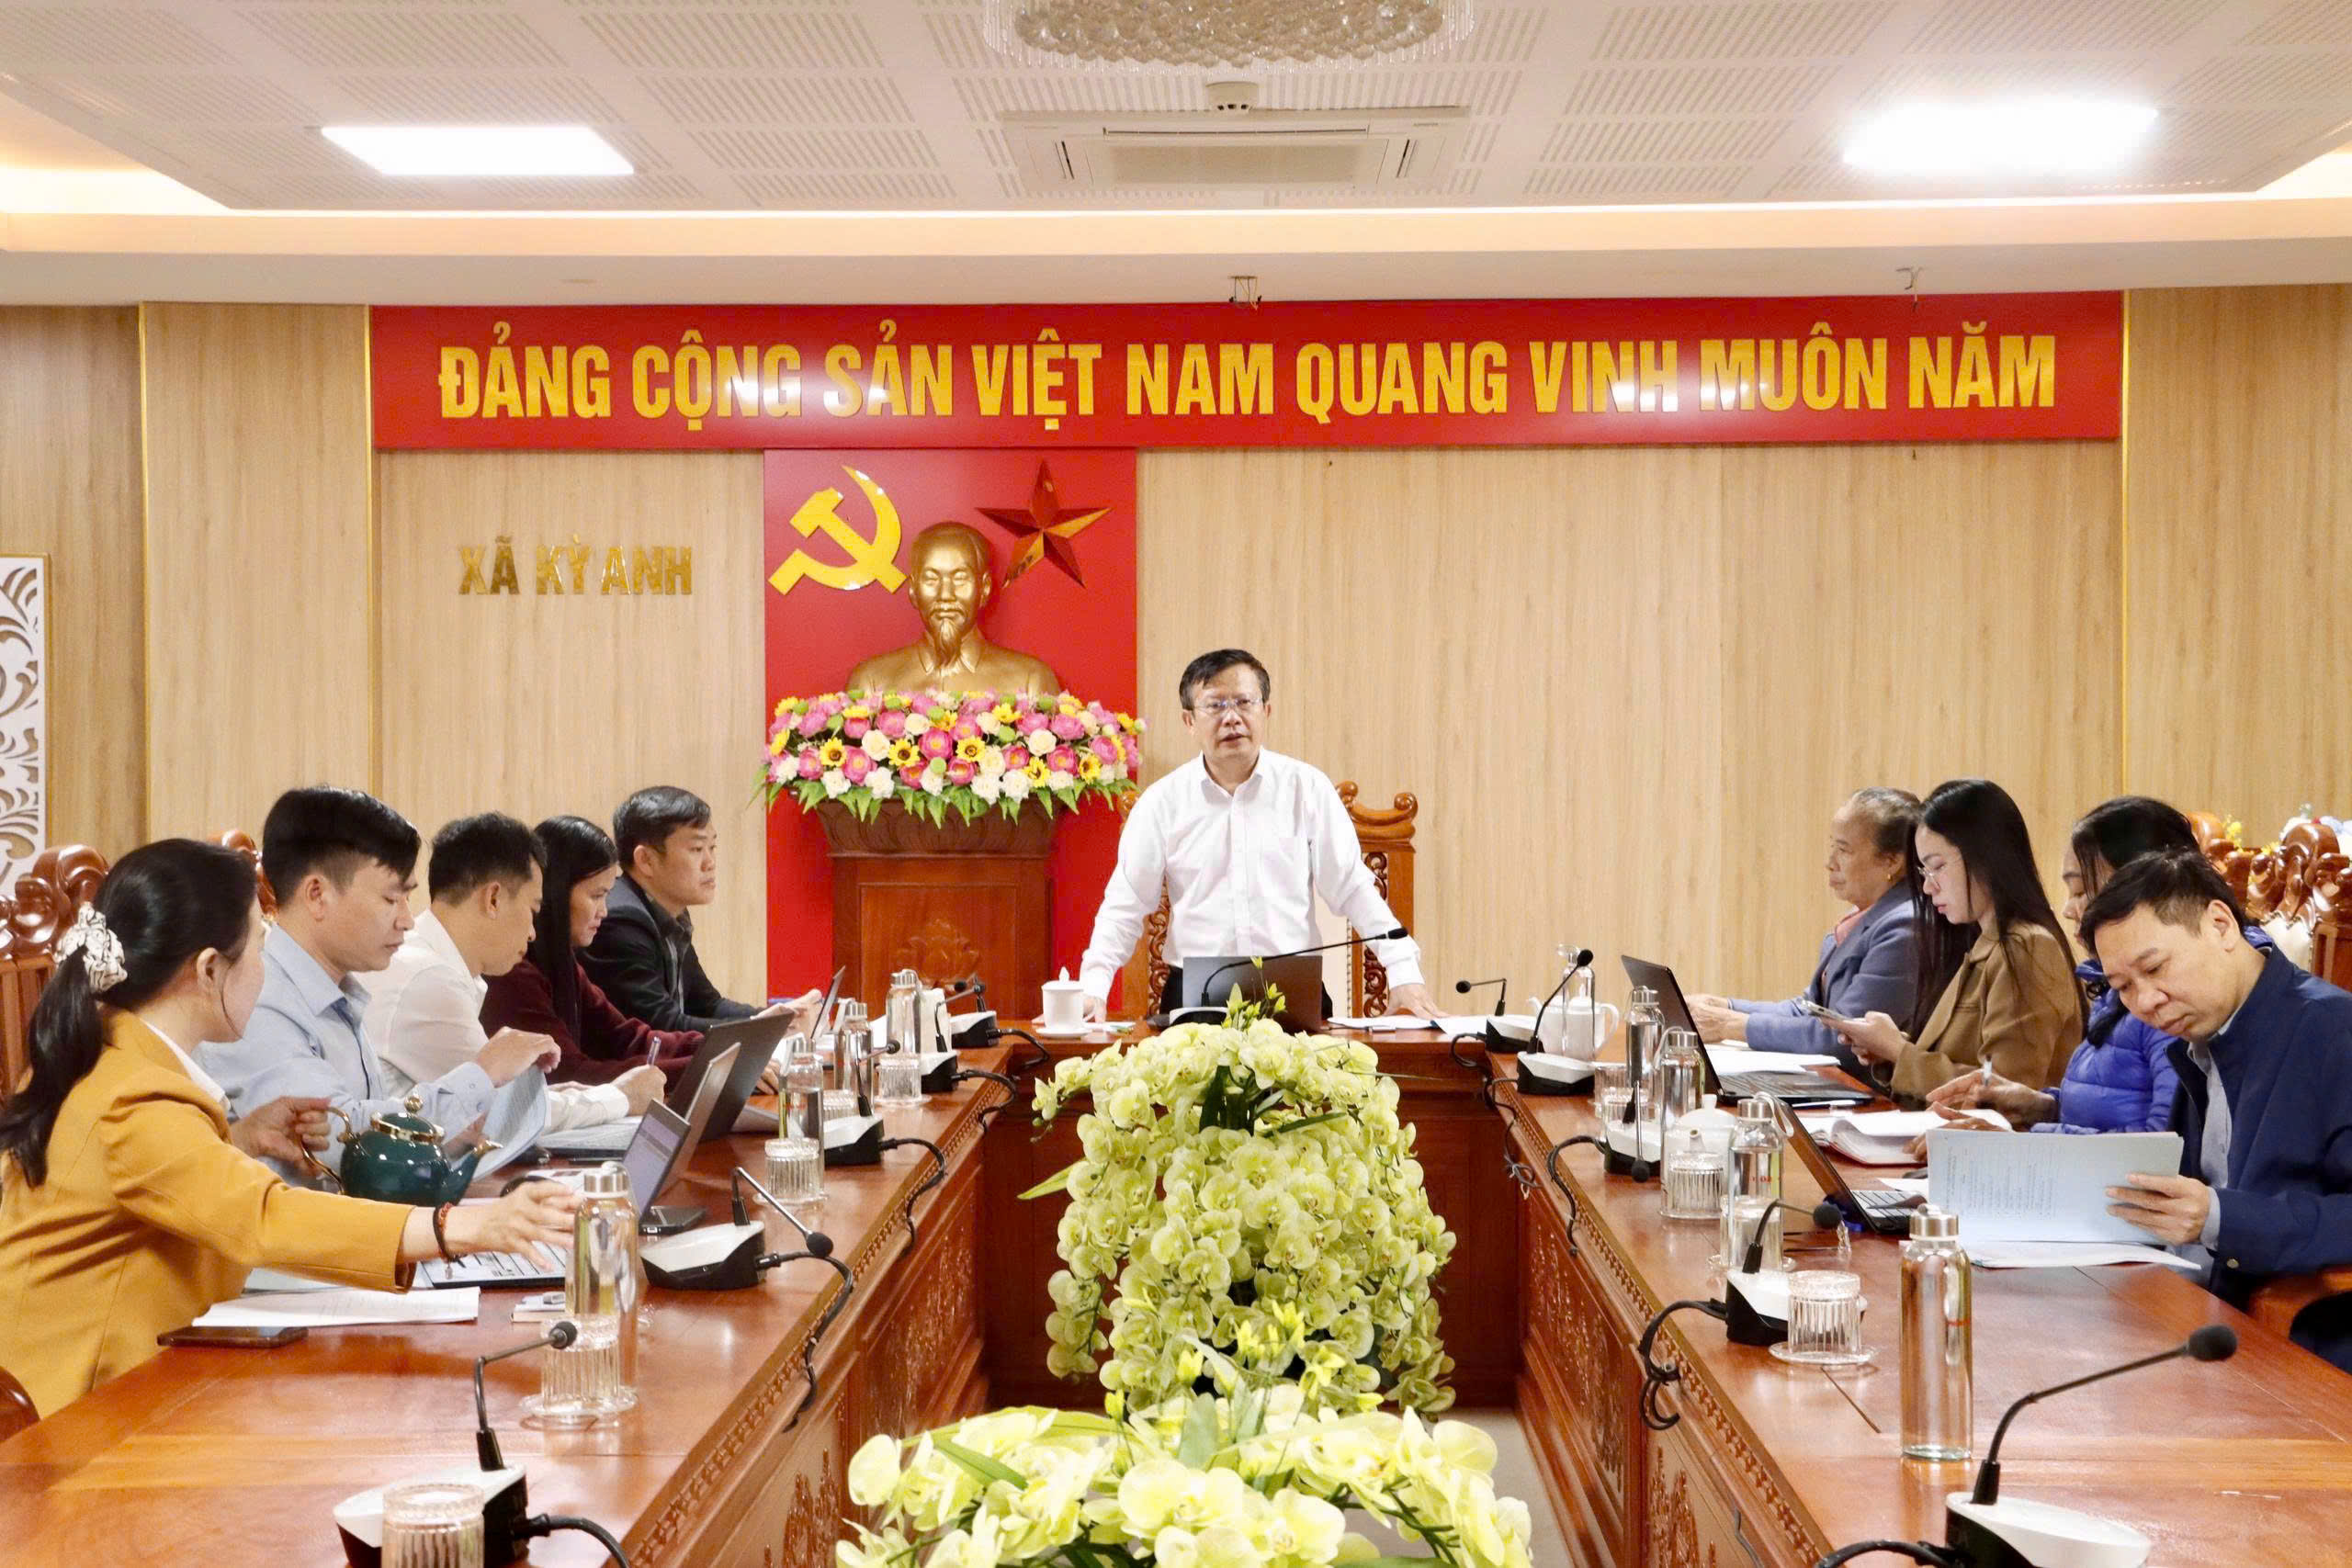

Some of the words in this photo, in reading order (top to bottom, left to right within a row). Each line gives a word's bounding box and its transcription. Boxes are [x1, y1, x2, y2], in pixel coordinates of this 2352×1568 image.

[438, 321, 611, 418] ĐẢNG
[632, 329, 802, 431] CỘNG
[823, 319, 953, 419] SẢN
[971, 328, 1102, 431] VIỆT
[1126, 344, 1274, 415] NAM
[1295, 341, 1508, 424] QUANG
[1529, 341, 1679, 413] VINH
[1700, 321, 1888, 412] MUÔN
[1908, 320, 2056, 409] NĂM
[458, 535, 519, 595] XÃ
[537, 533, 591, 595] KỲ
[601, 545, 692, 595] ANH
